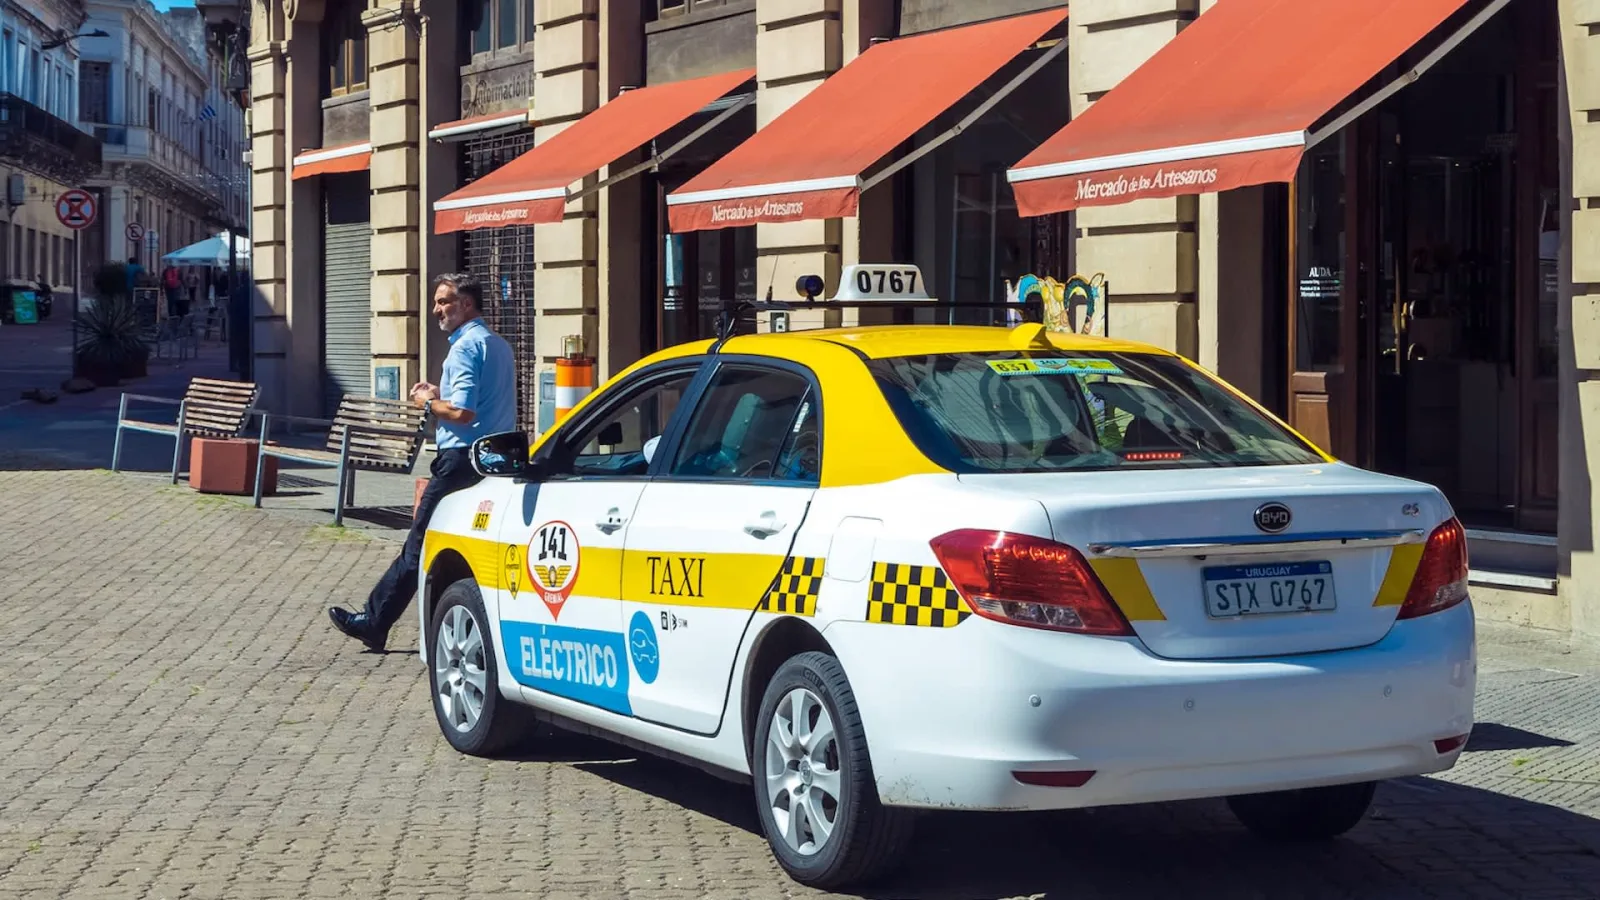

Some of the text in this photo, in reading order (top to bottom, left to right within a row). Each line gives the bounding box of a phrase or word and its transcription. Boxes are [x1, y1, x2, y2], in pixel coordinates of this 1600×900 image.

[1075, 168, 1217, 200] Mercado de los Artesanos
[711, 203, 747, 223] Mercado
[760, 200, 803, 216] Artesanos
[857, 270, 917, 293] 0767
[1260, 511, 1288, 523] BYD
[538, 526, 568, 561] 141
[646, 556, 706, 598] TAXI
[1245, 566, 1291, 577] URUGUAY
[1215, 578, 1325, 610] STX 0767
[520, 624, 617, 688] ELÉCTRICO
